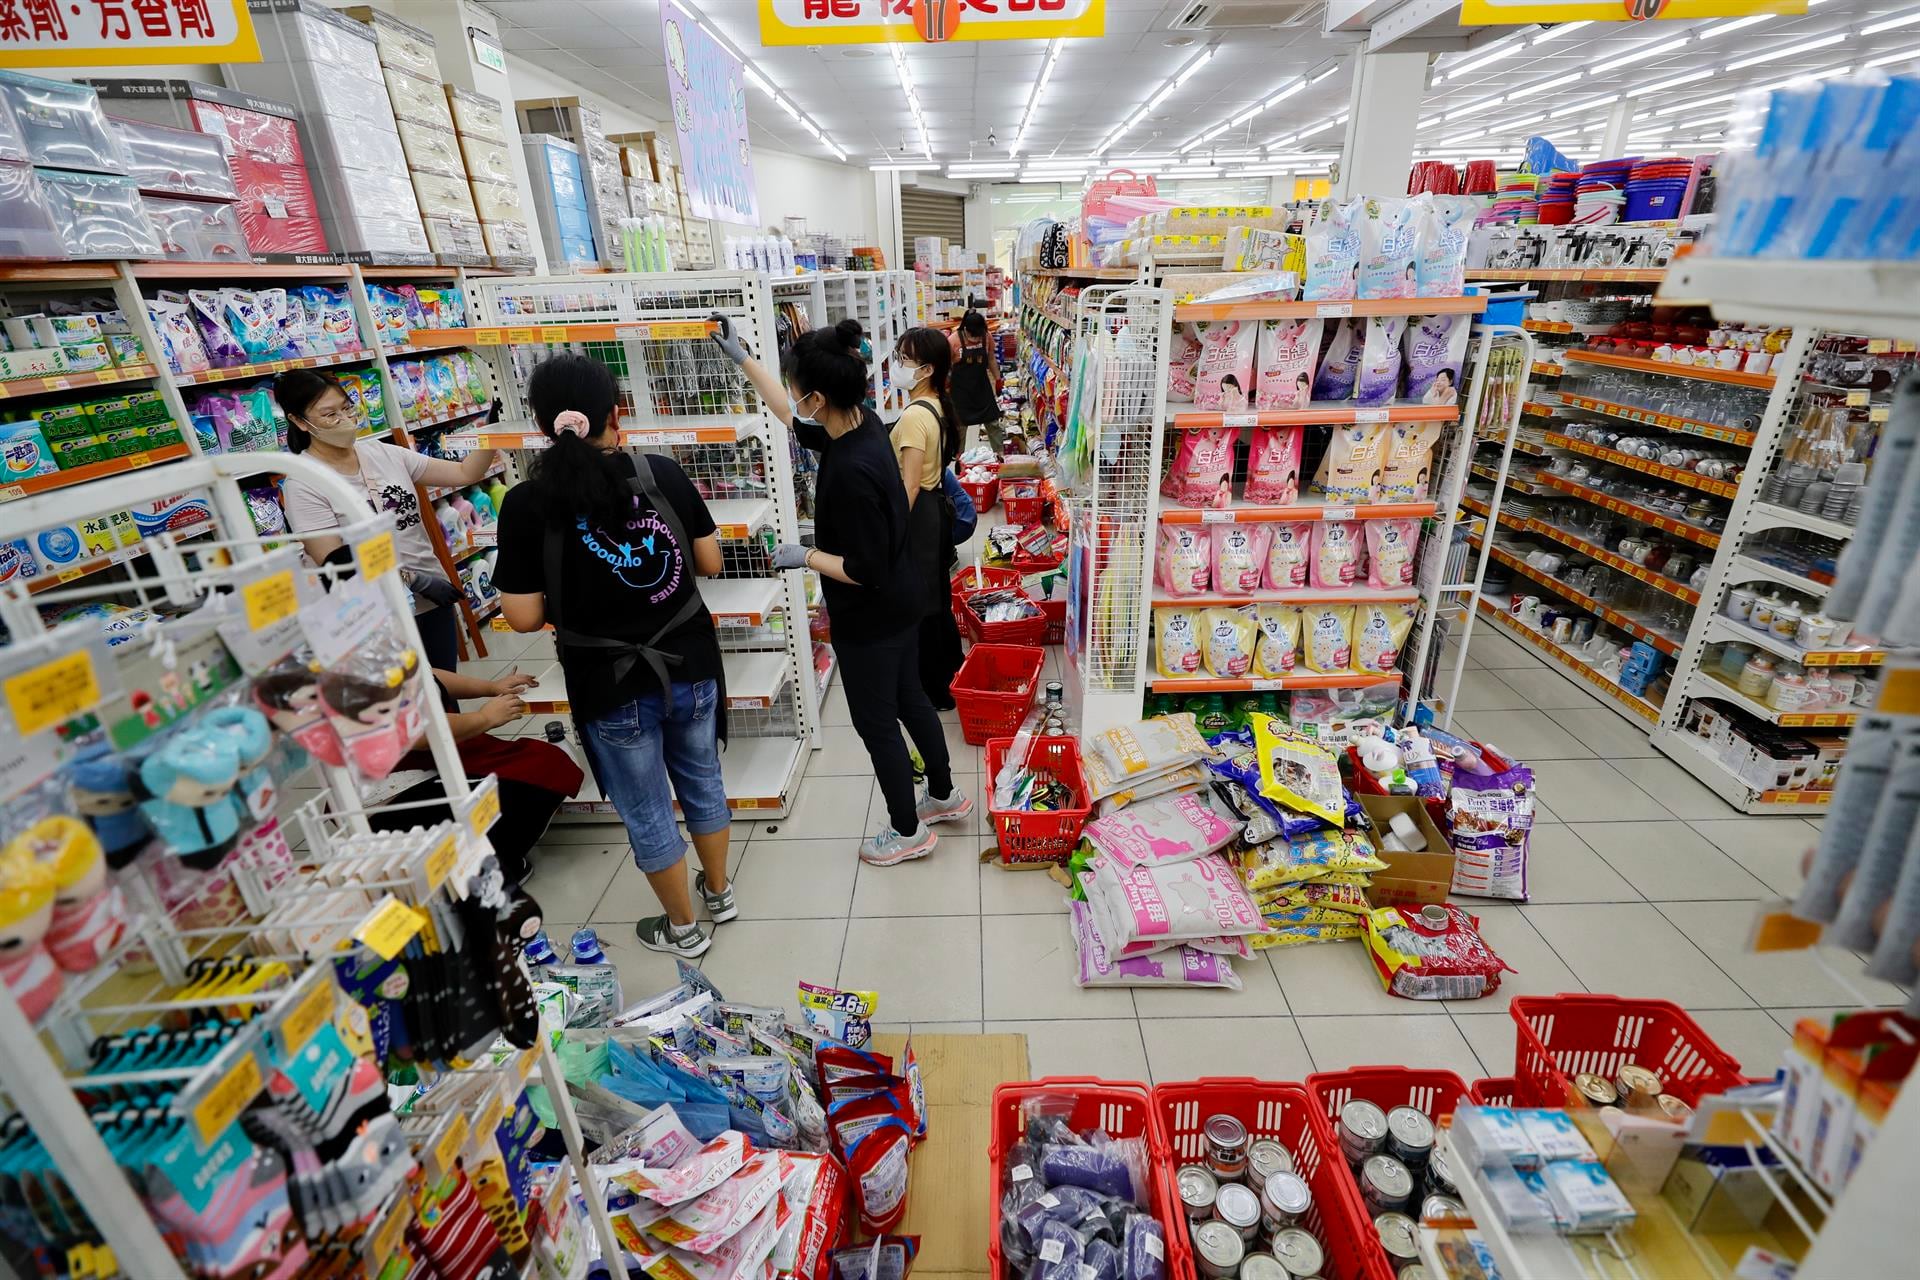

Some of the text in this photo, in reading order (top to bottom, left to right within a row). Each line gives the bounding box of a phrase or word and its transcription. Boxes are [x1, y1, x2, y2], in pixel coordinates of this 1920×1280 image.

[635, 328, 648, 337] 139
[646, 435, 659, 443] 115
[682, 433, 695, 441] 115
[8, 488, 23, 497] 109
[84, 511, 130, 534] 水晶肥皂
[650, 548, 683, 604] ACTIVITIES
